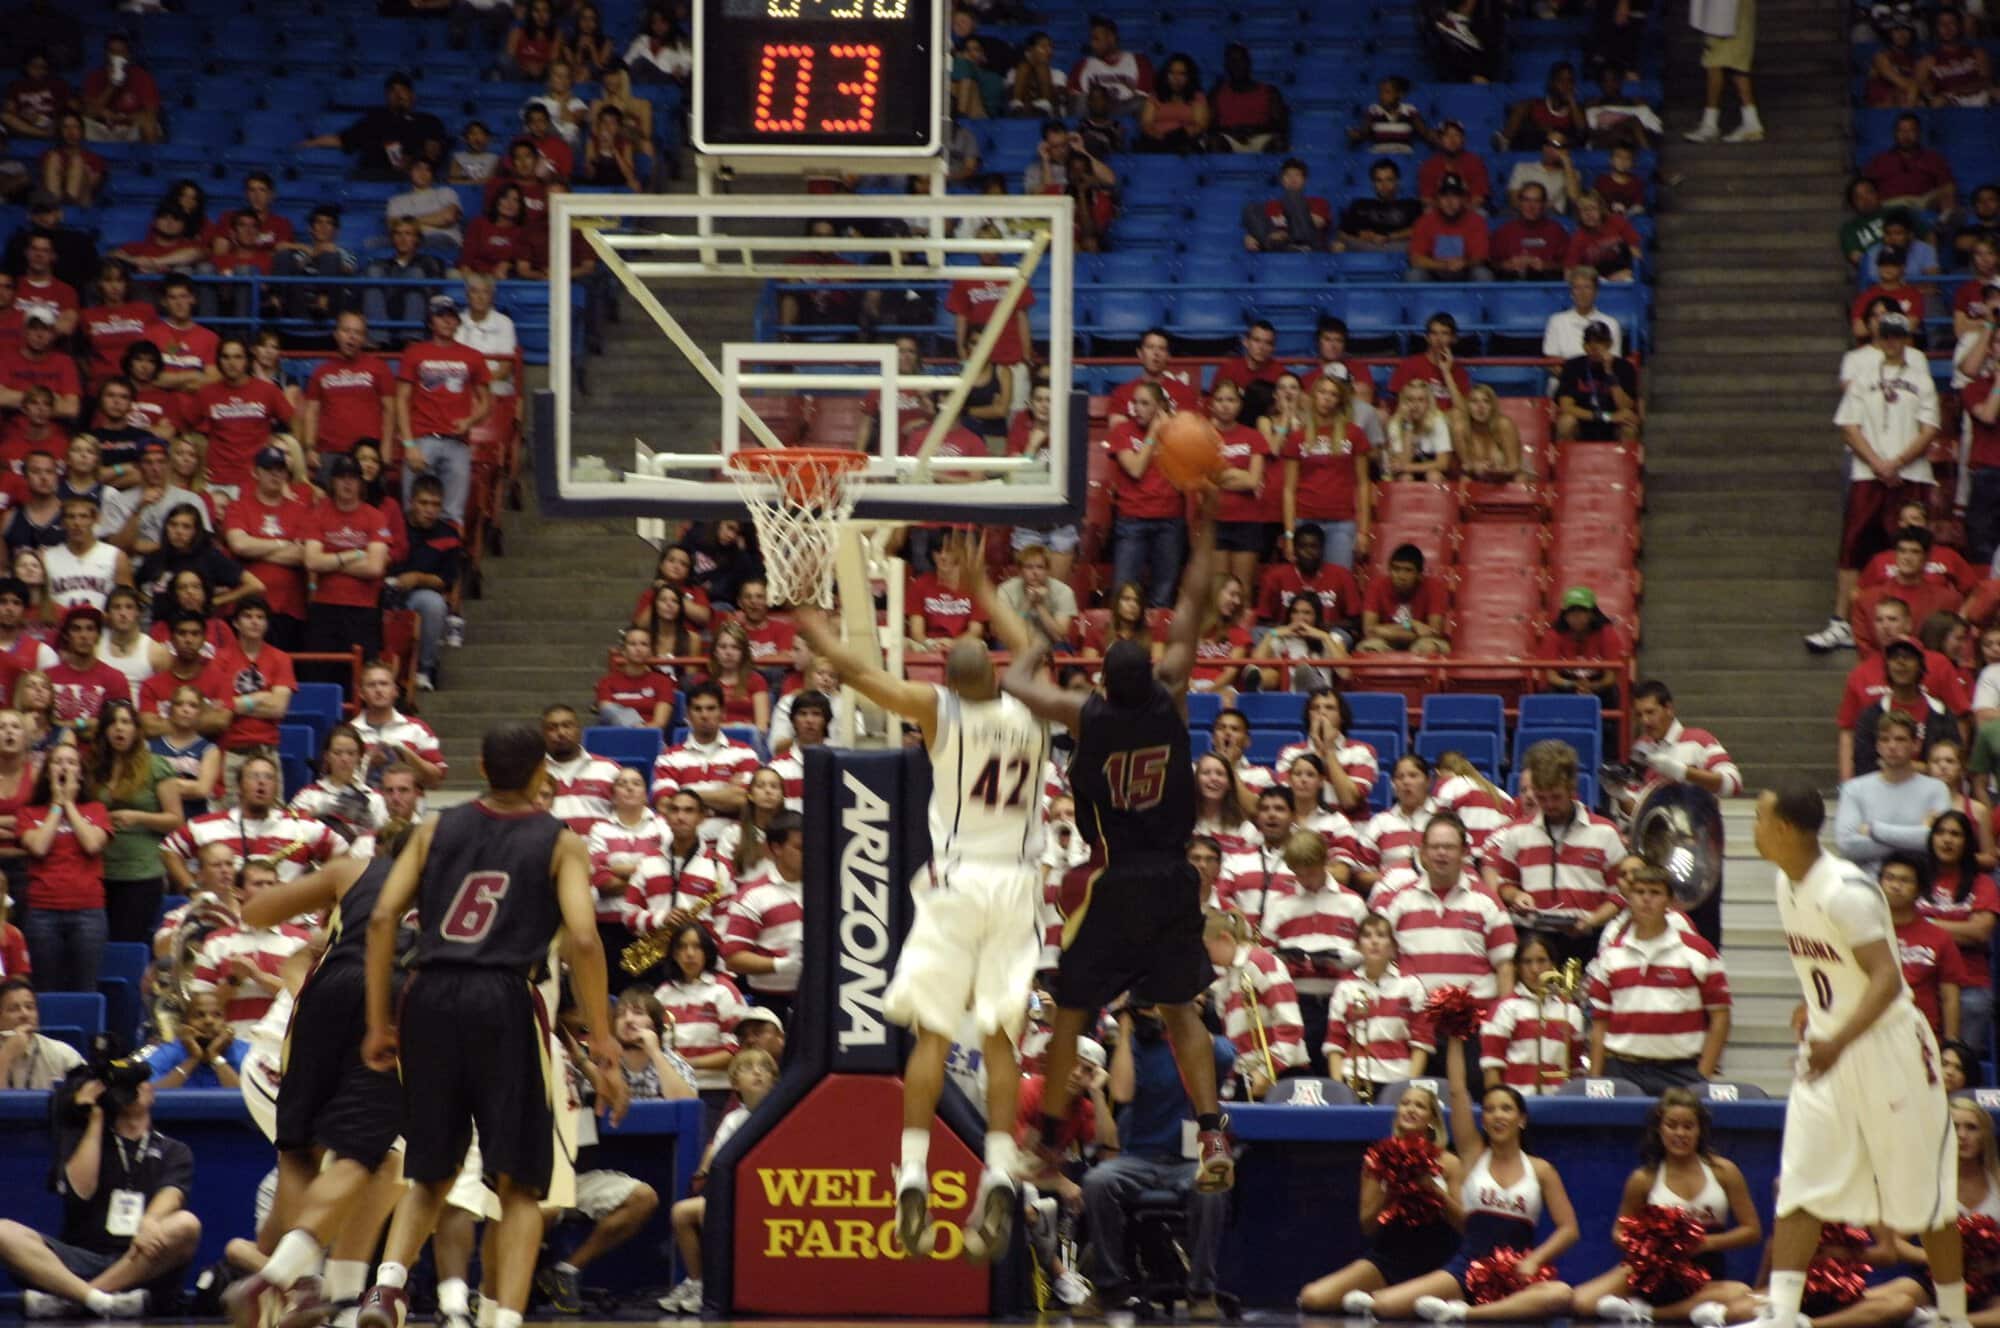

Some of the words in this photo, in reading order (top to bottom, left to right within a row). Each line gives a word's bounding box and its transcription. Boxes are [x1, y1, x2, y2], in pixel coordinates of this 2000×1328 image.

[755, 44, 881, 132] 03
[969, 755, 1031, 809] 42
[1103, 744, 1171, 812] 15
[440, 870, 510, 943] 6
[838, 768, 891, 1046] ARIZONA
[1810, 966, 1833, 1011] 0
[757, 1168, 968, 1209] WELS
